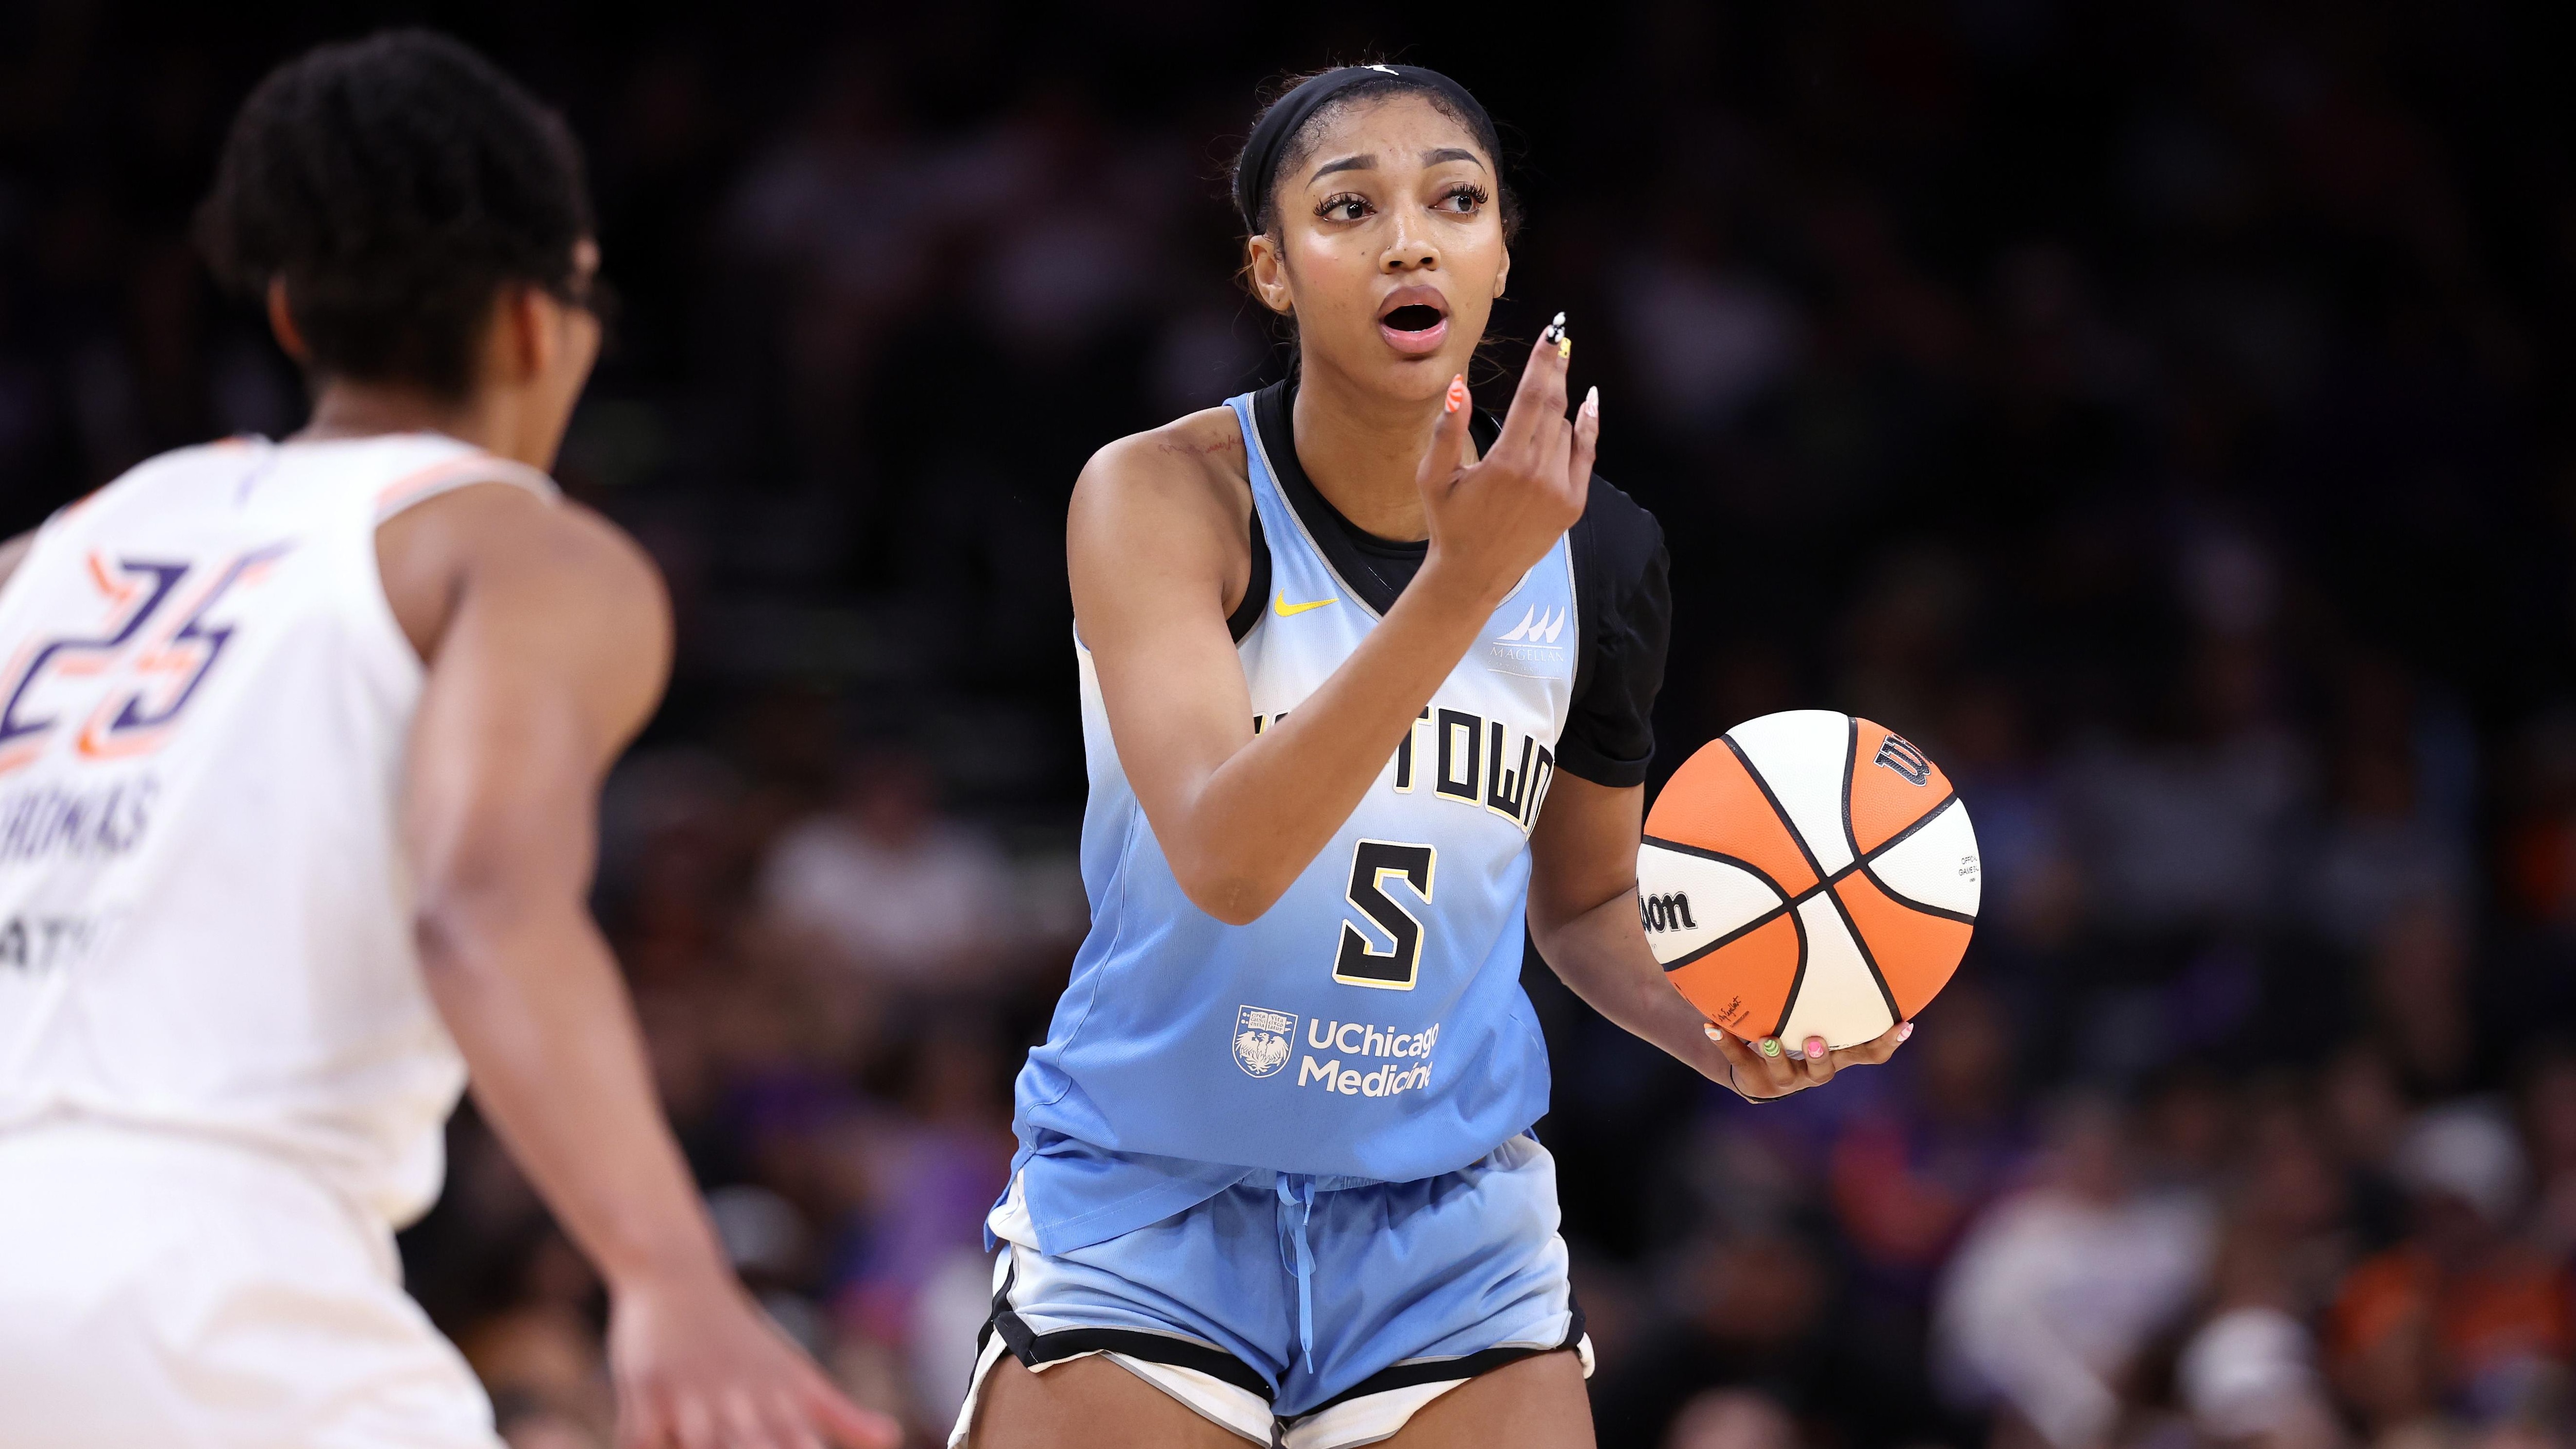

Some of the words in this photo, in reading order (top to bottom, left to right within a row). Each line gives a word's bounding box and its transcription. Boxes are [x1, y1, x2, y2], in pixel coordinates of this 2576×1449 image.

[0, 541, 296, 769] 25
[1489, 646, 1564, 662] MAGELLAN
[1332, 838, 1437, 991] 5
[1308, 1018, 1439, 1059] UChicago
[1298, 1055, 1433, 1097] Medicine
